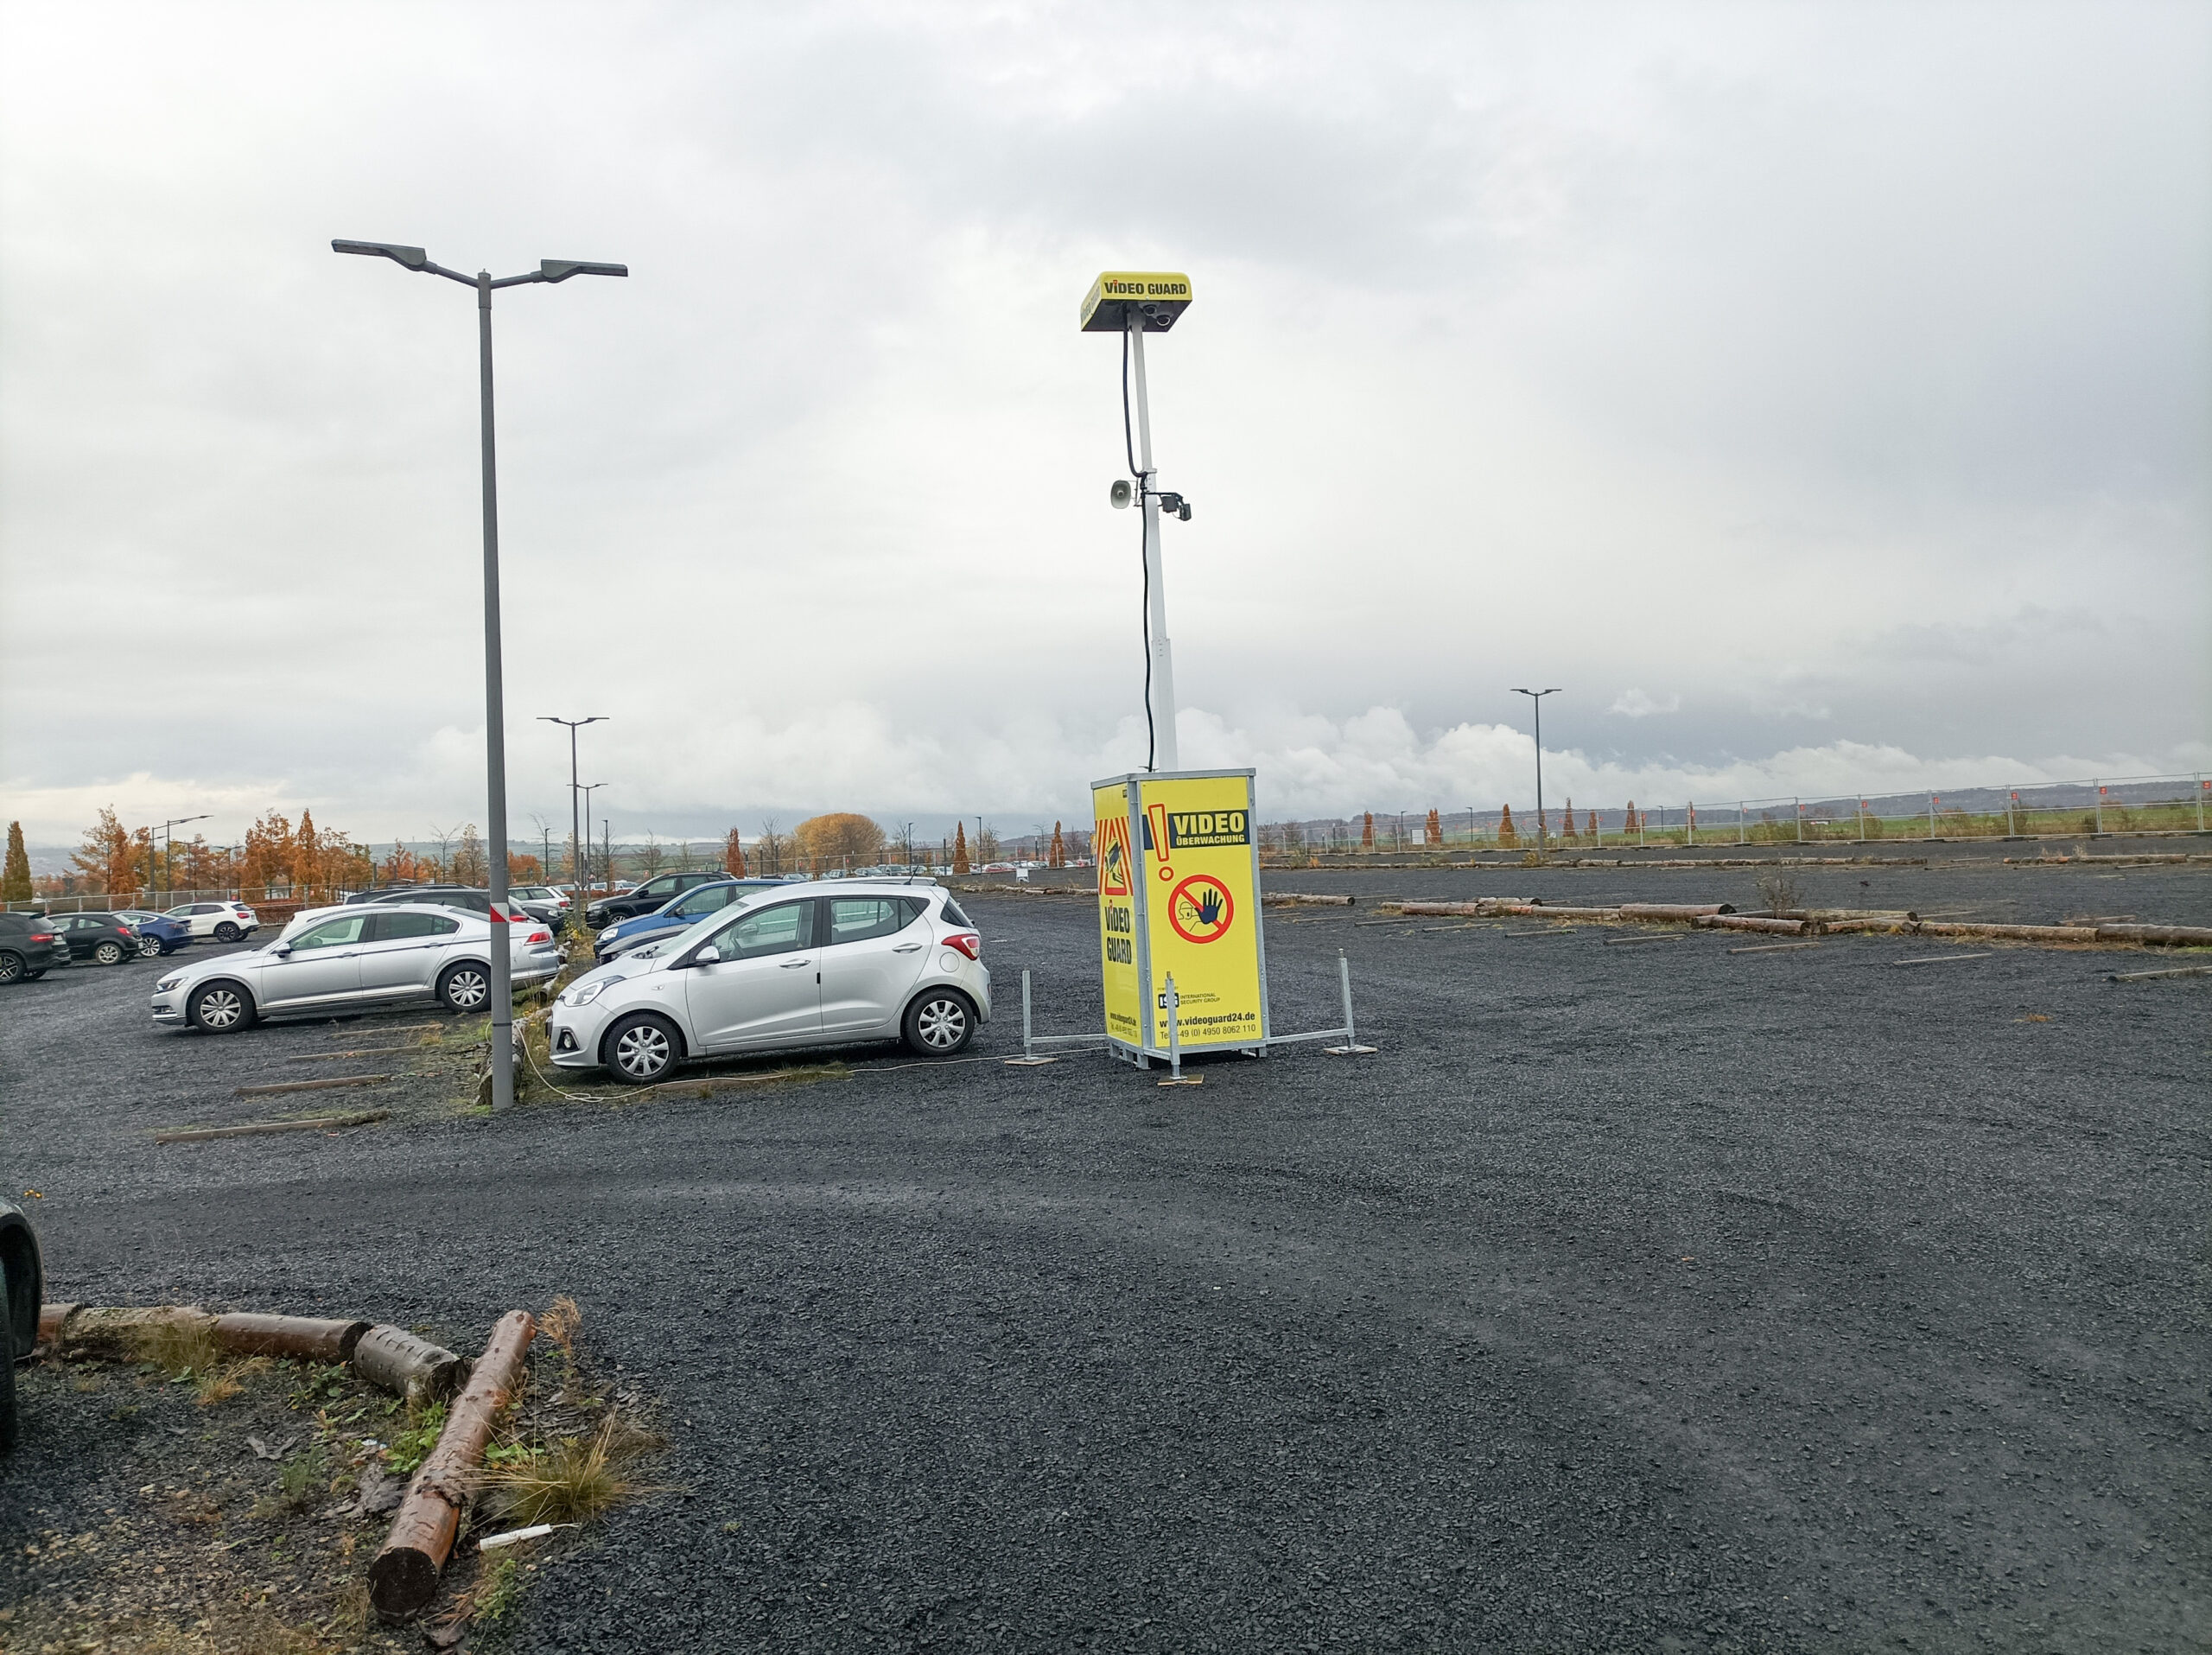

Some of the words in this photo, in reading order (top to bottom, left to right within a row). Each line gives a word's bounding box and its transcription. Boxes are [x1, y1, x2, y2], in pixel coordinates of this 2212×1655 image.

[1147, 283, 1187, 295] GUARD
[1173, 812, 1245, 836] VIDEO
[1176, 834, 1245, 846] ÜBERWACHUNG
[1107, 936, 1132, 964] GUARD
[1159, 1011, 1255, 1028] ww.videoguard24.de
[1191, 1028, 1201, 1037] (0)
[1202, 1028, 1221, 1036] 4950
[1222, 1025, 1240, 1034] 8062
[1243, 1024, 1256, 1033] 110
